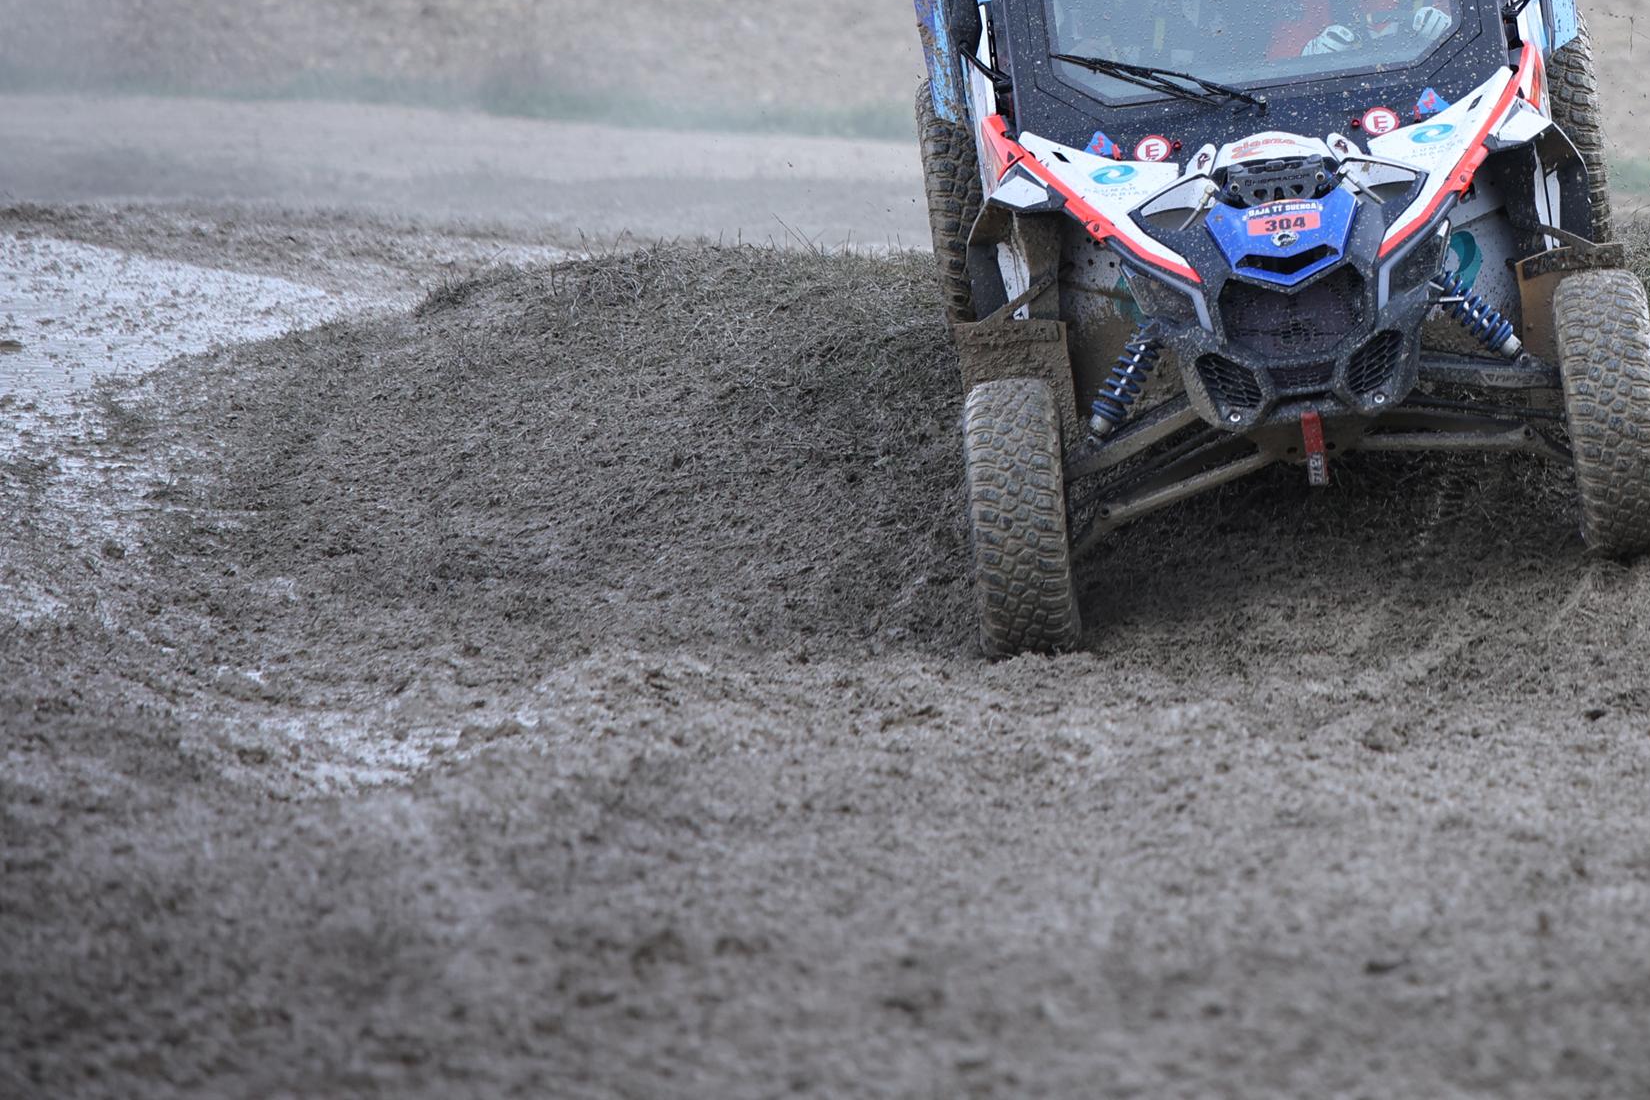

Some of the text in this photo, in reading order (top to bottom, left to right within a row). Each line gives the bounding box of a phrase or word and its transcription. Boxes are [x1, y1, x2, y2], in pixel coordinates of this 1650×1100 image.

[1373, 115, 1388, 130] E
[1145, 143, 1160, 158] E
[1248, 207, 1270, 217] BAJA
[1271, 204, 1283, 213] TT
[1265, 216, 1306, 232] 304
